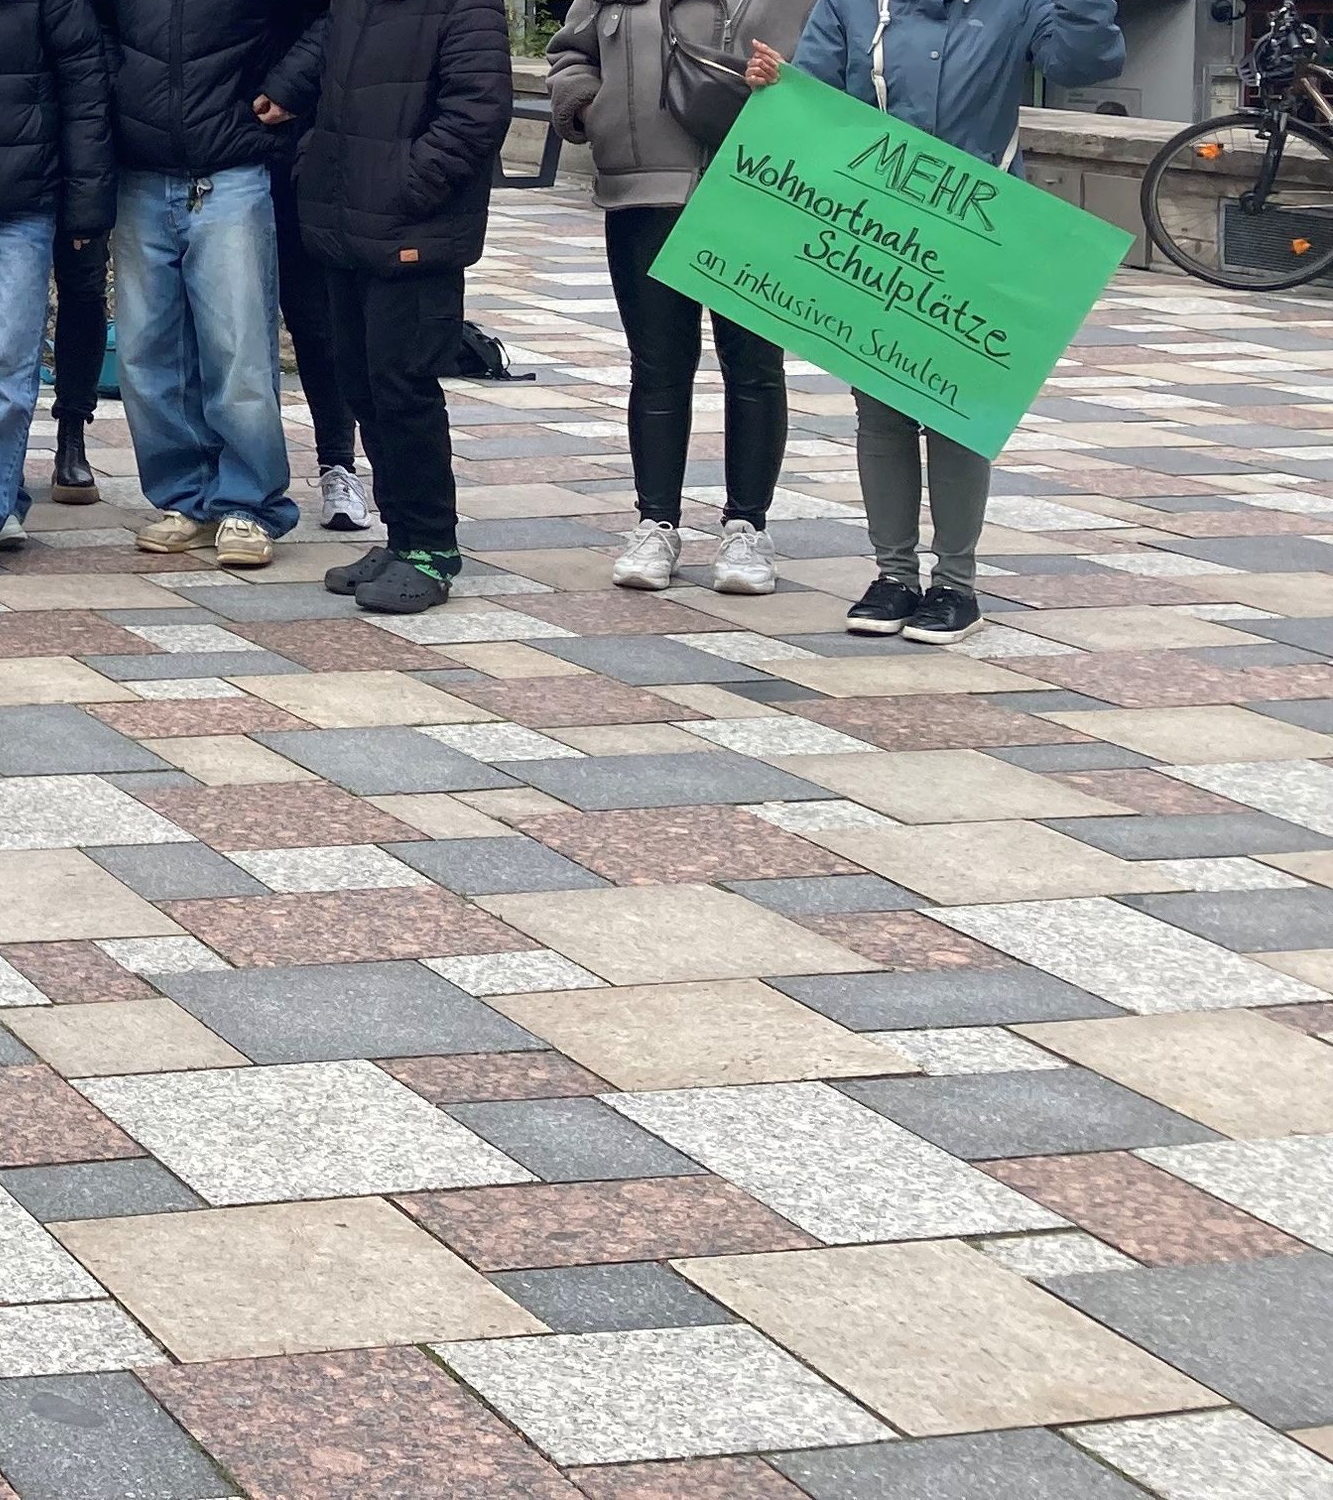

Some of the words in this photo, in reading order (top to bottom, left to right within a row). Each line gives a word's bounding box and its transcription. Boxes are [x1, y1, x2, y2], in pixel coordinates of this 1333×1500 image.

[735, 144, 945, 275] Wohnortnahe
[847, 132, 1000, 232] MEHR
[696, 250, 727, 277] an
[733, 263, 854, 342] inklusiven
[859, 328, 959, 407] Schulen
[803, 230, 1012, 358] Schulplätze
